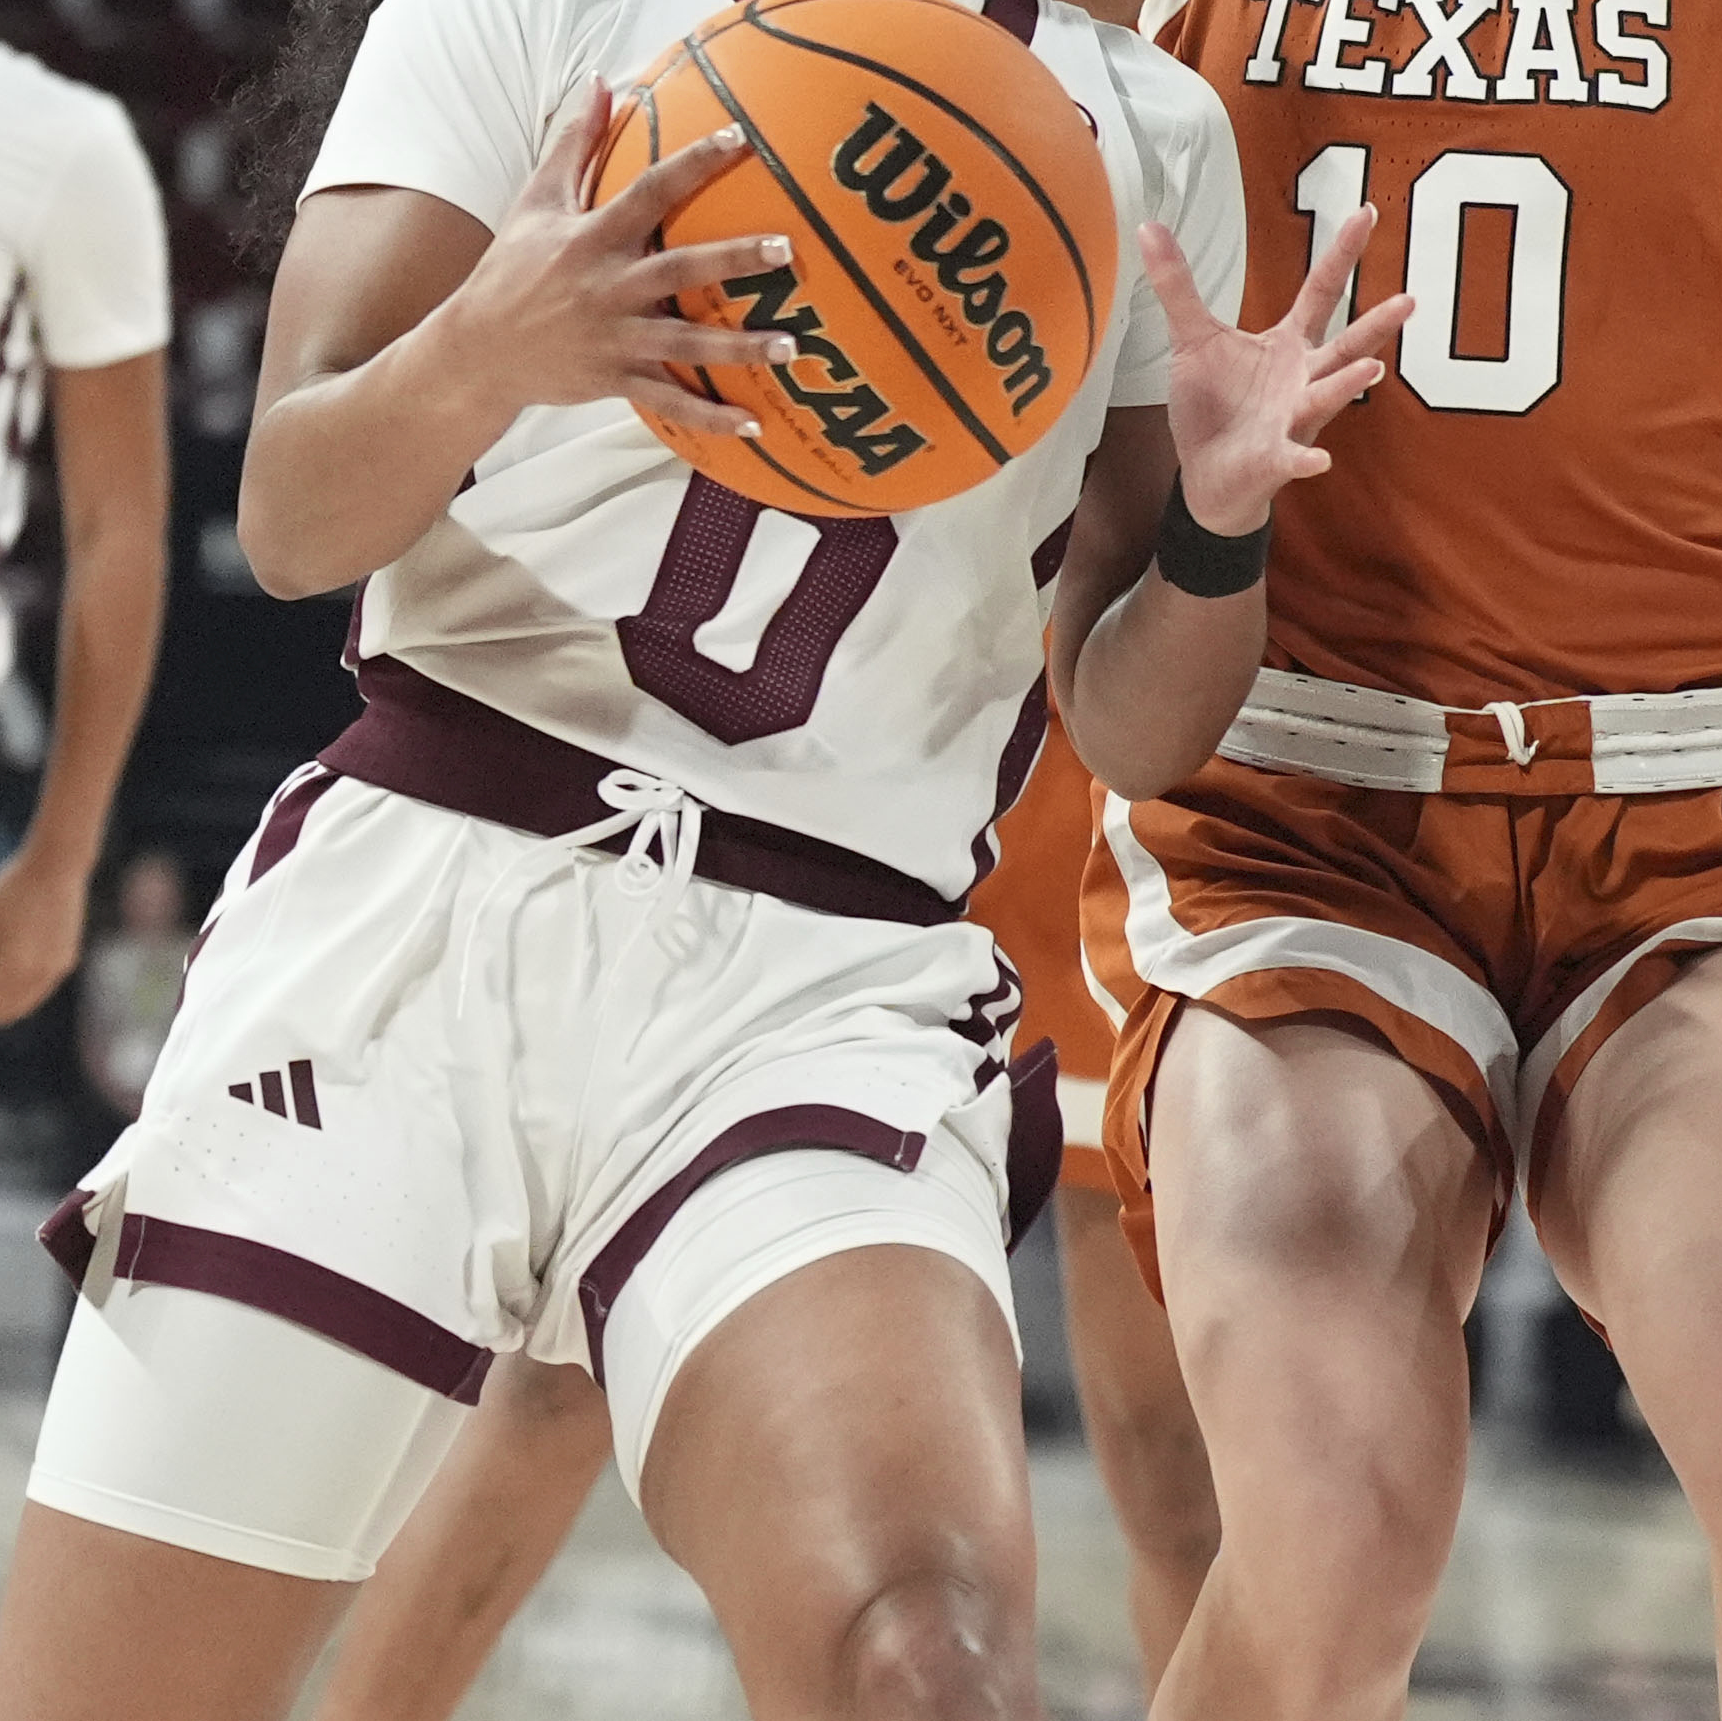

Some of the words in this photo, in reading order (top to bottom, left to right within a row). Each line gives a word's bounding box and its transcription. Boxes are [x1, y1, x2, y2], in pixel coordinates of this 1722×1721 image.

[721, 264, 929, 477] NCAA
[831, 102, 1053, 418] Wilson
[893, 258, 934, 303] EVO
[1293, 143, 1574, 418] 10
